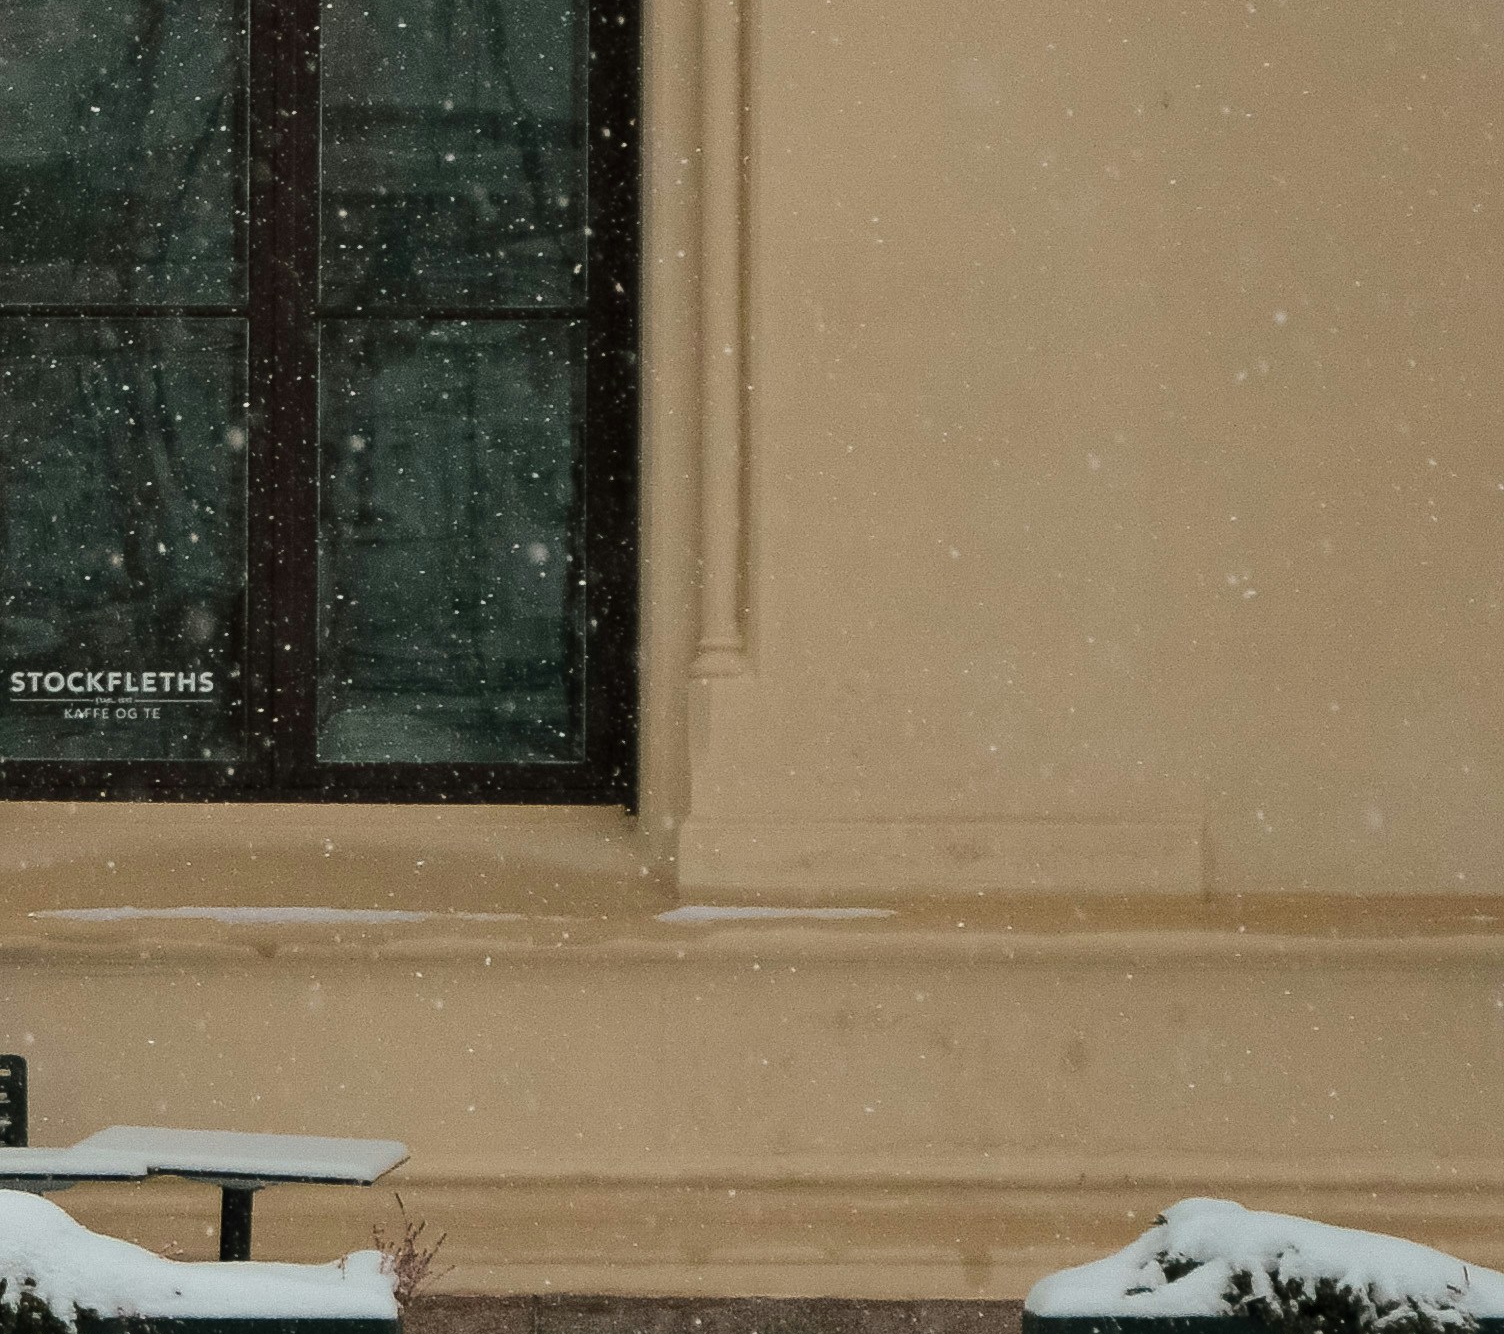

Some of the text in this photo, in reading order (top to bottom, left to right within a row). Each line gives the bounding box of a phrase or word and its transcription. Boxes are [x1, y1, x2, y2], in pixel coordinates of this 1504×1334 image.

[10, 671, 214, 693] STOCKFLETHS
[64, 707, 161, 719] KAFFE OG TE
